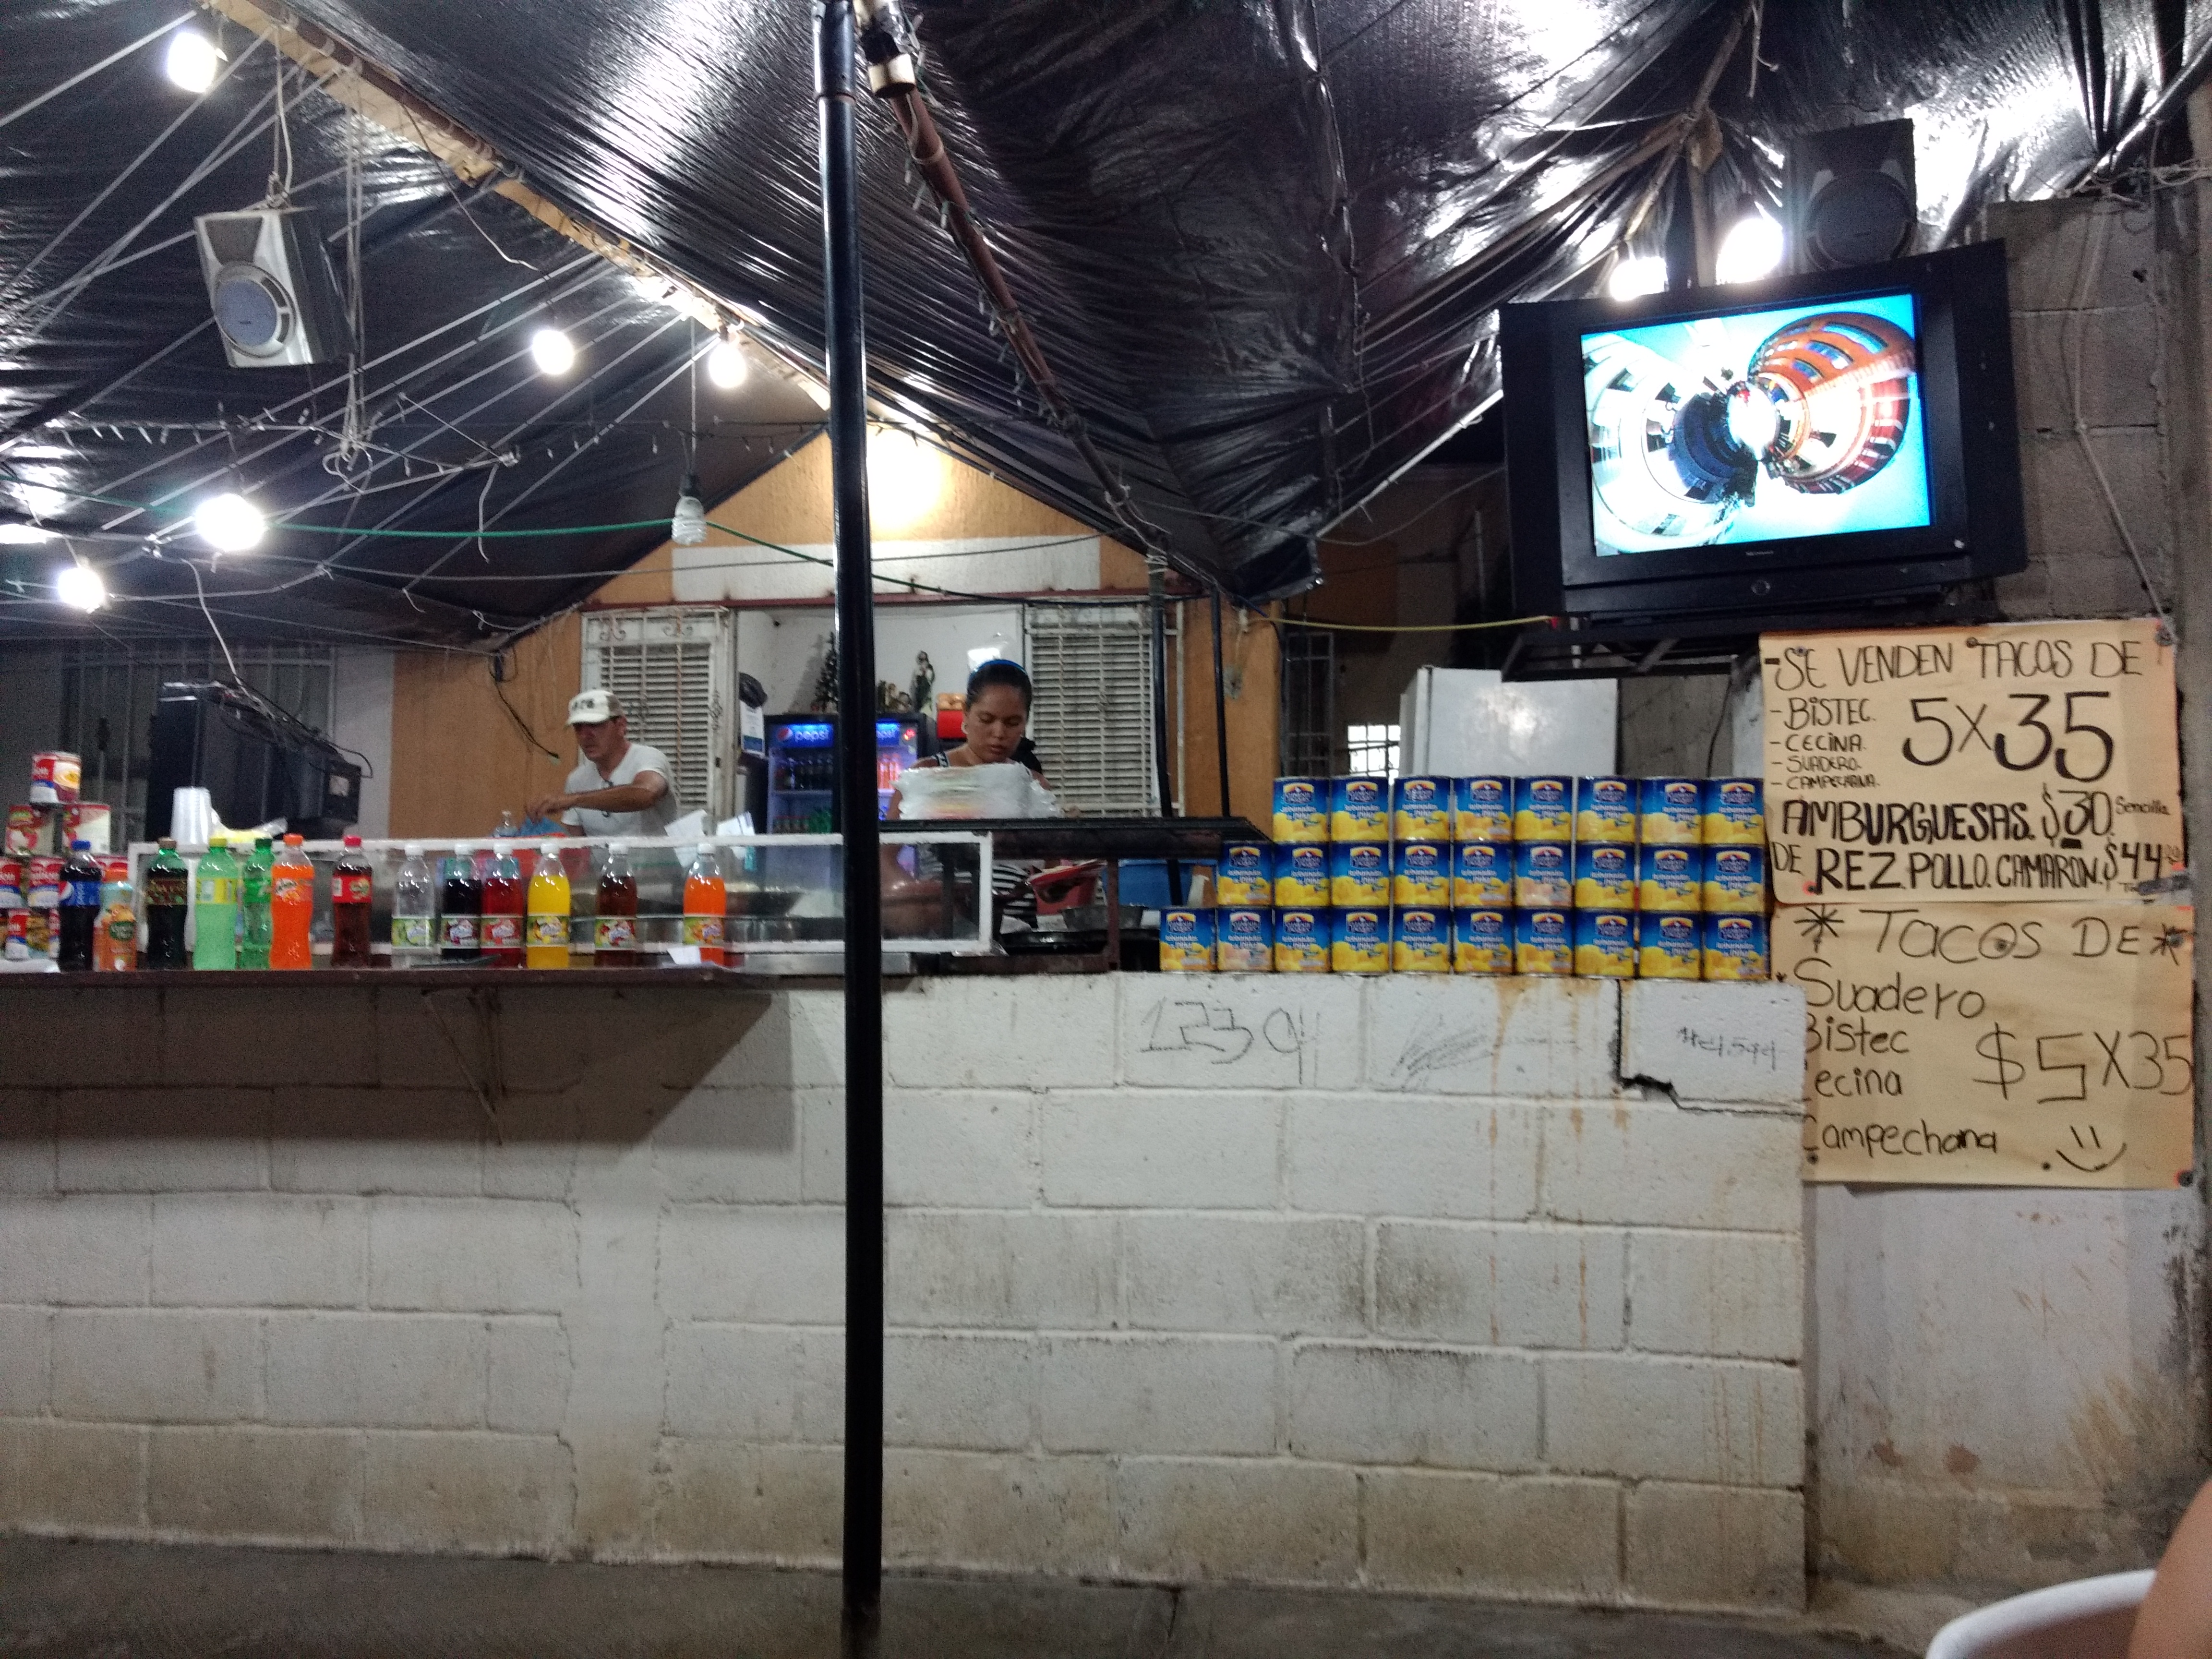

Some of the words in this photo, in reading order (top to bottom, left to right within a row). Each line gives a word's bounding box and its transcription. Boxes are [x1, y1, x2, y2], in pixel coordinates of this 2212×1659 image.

[1837, 642, 1954, 687] VENDEN
[1970, 639, 2073, 678] TACOS
[2091, 640, 2143, 678] DE
[1771, 841, 1804, 876] DE
[2072, 916, 2142, 958] DE
[1793, 957, 1986, 1020] Suadero
[1803, 1062, 1903, 1100] ecina
